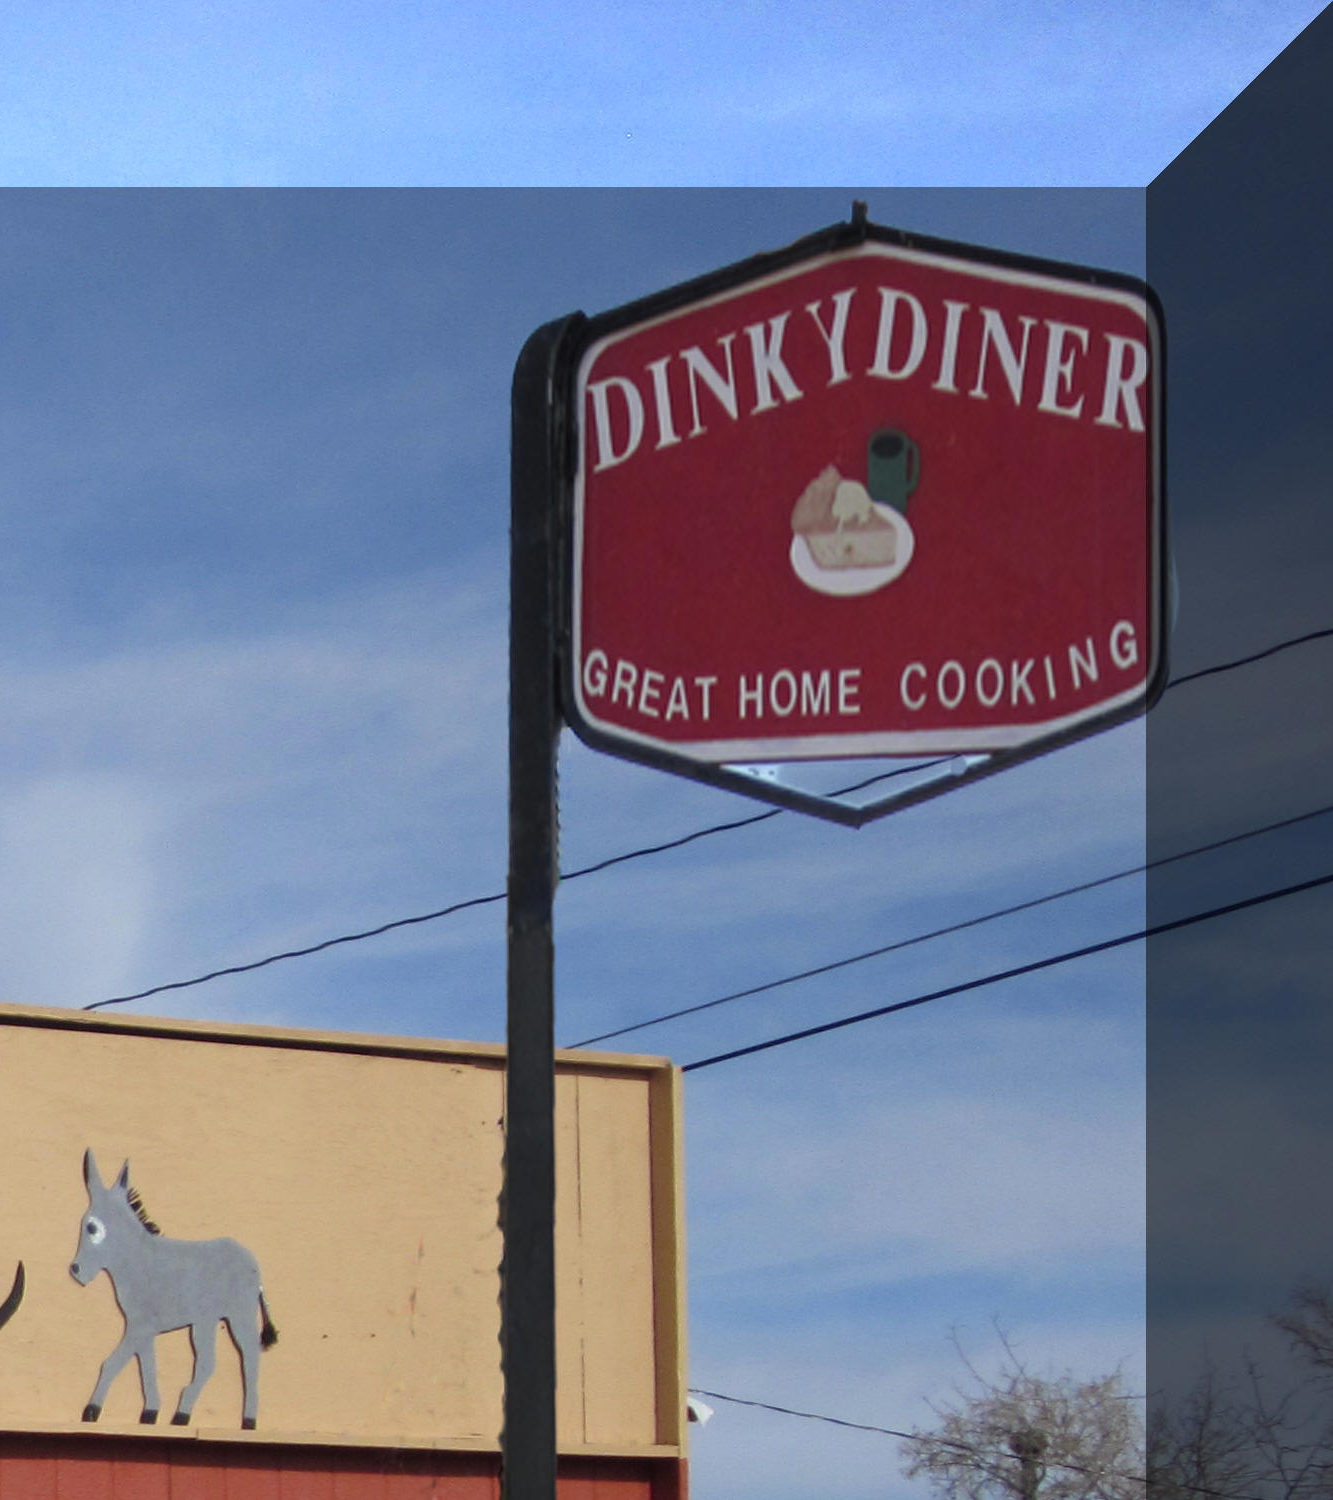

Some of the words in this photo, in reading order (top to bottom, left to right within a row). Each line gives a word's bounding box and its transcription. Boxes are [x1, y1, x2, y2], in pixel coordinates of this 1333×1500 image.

[586, 287, 857, 472] DINKY
[867, 286, 1151, 433] DINER
[583, 648, 718, 720] GREAT
[739, 668, 862, 718] HOME
[900, 619, 1139, 711] COOKING
